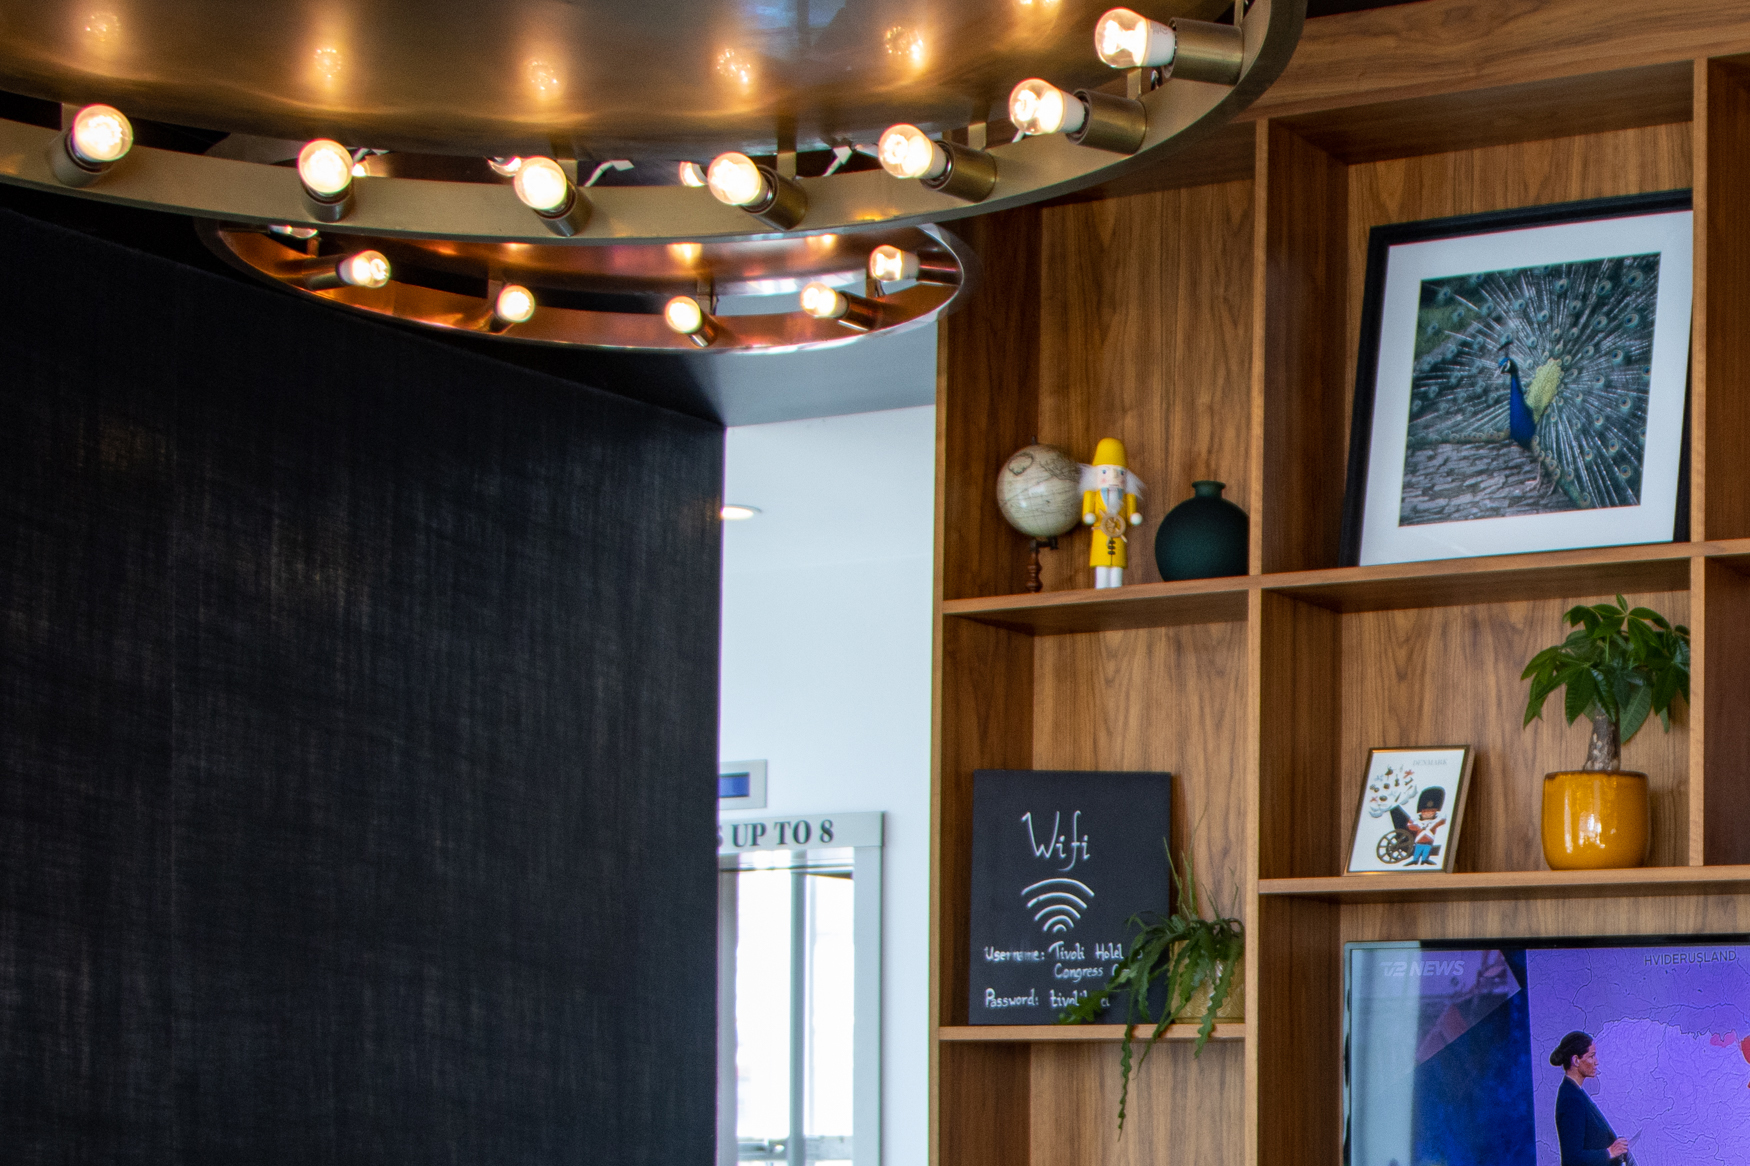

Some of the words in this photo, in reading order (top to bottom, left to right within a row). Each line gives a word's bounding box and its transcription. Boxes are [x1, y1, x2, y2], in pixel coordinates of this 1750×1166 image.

[731, 822, 767, 848] UP
[774, 819, 812, 845] TO
[819, 819, 835, 844] 8
[1021, 810, 1091, 872] Wifi
[983, 945, 1046, 962] Username:
[1048, 940, 1086, 960] Tivoli
[1644, 950, 1737, 966] HVIDERUSLAND
[1054, 962, 1104, 983] Congress
[1409, 960, 1465, 977] NEWS
[984, 987, 1040, 1009] Password:
